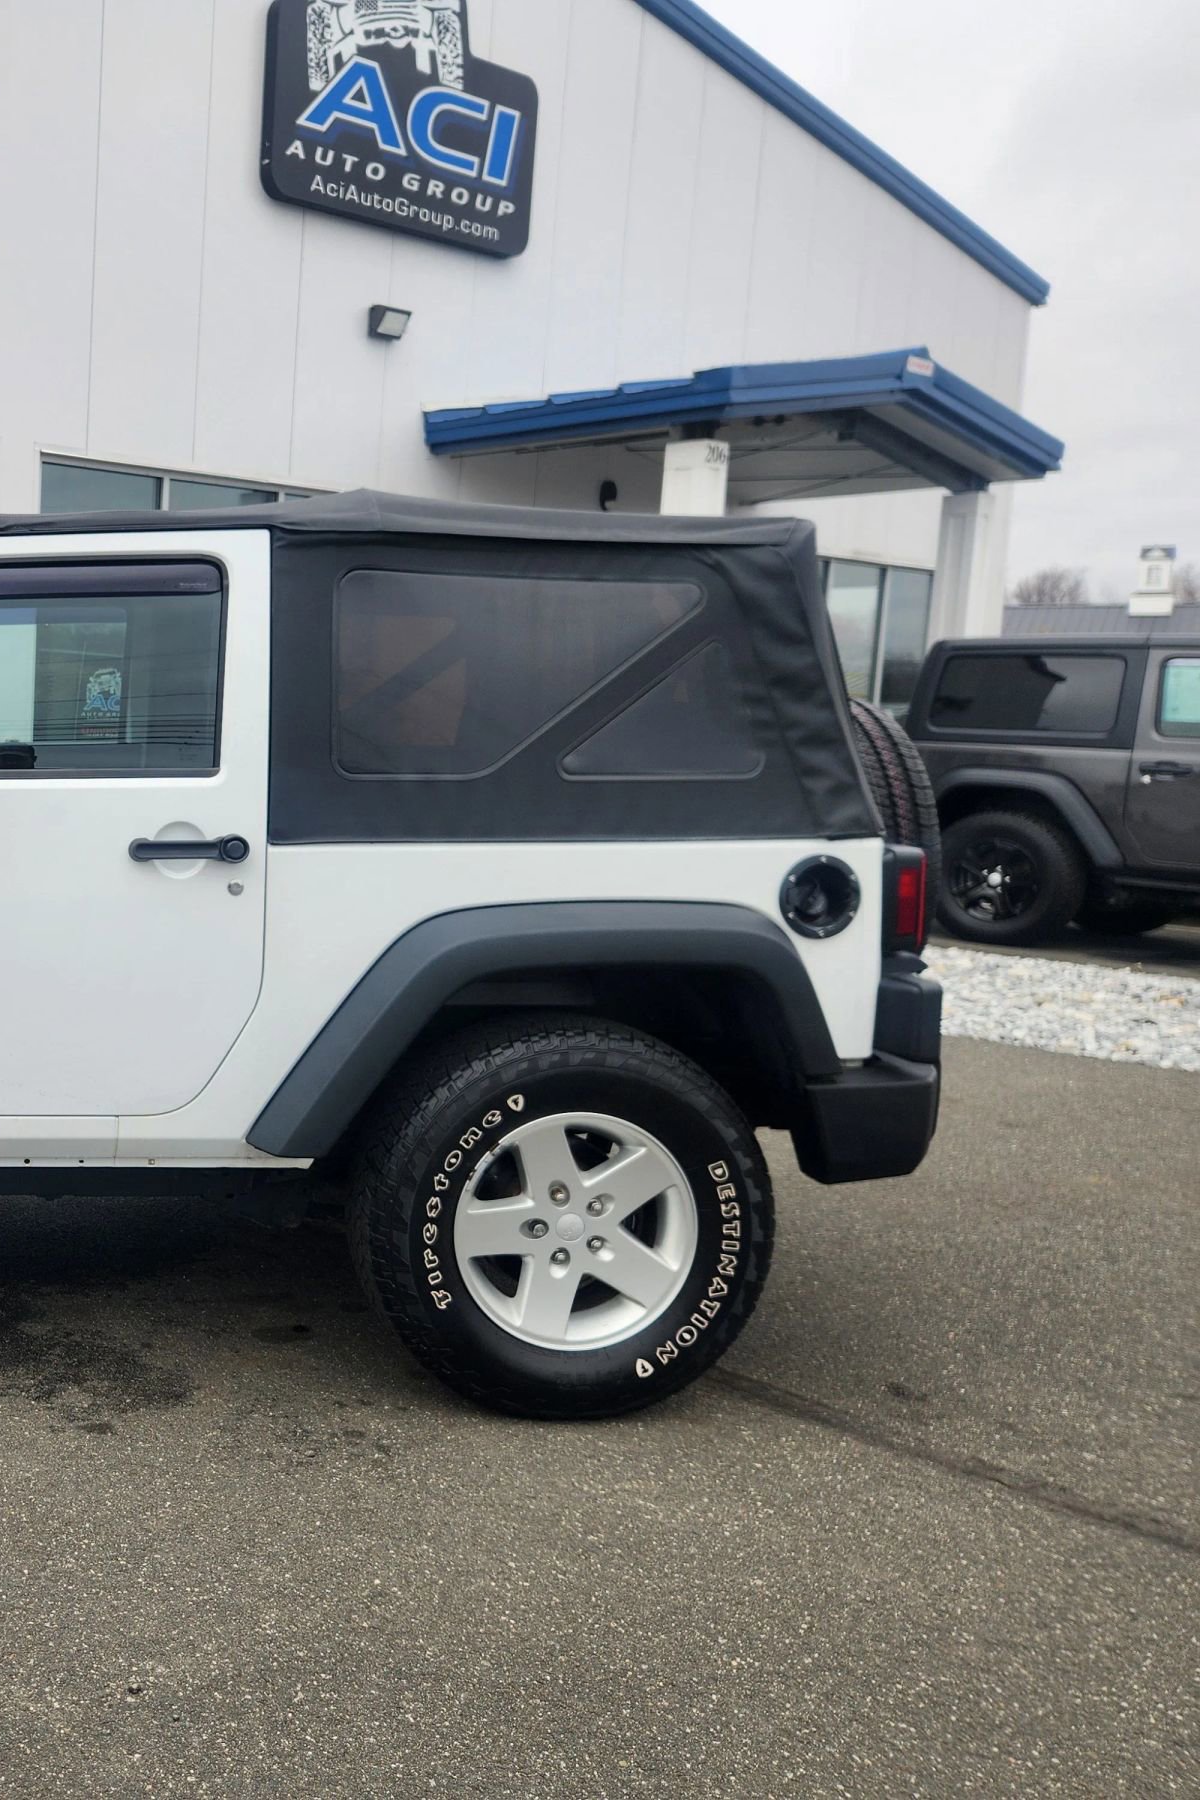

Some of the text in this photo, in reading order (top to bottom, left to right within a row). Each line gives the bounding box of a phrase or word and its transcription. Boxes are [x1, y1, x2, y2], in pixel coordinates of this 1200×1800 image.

[295, 55, 521, 187] ACI
[285, 139, 517, 217] AUTO GROUP
[309, 173, 501, 241] AciAutoGroup.com
[656, 1160, 741, 1366] DESTINATION
